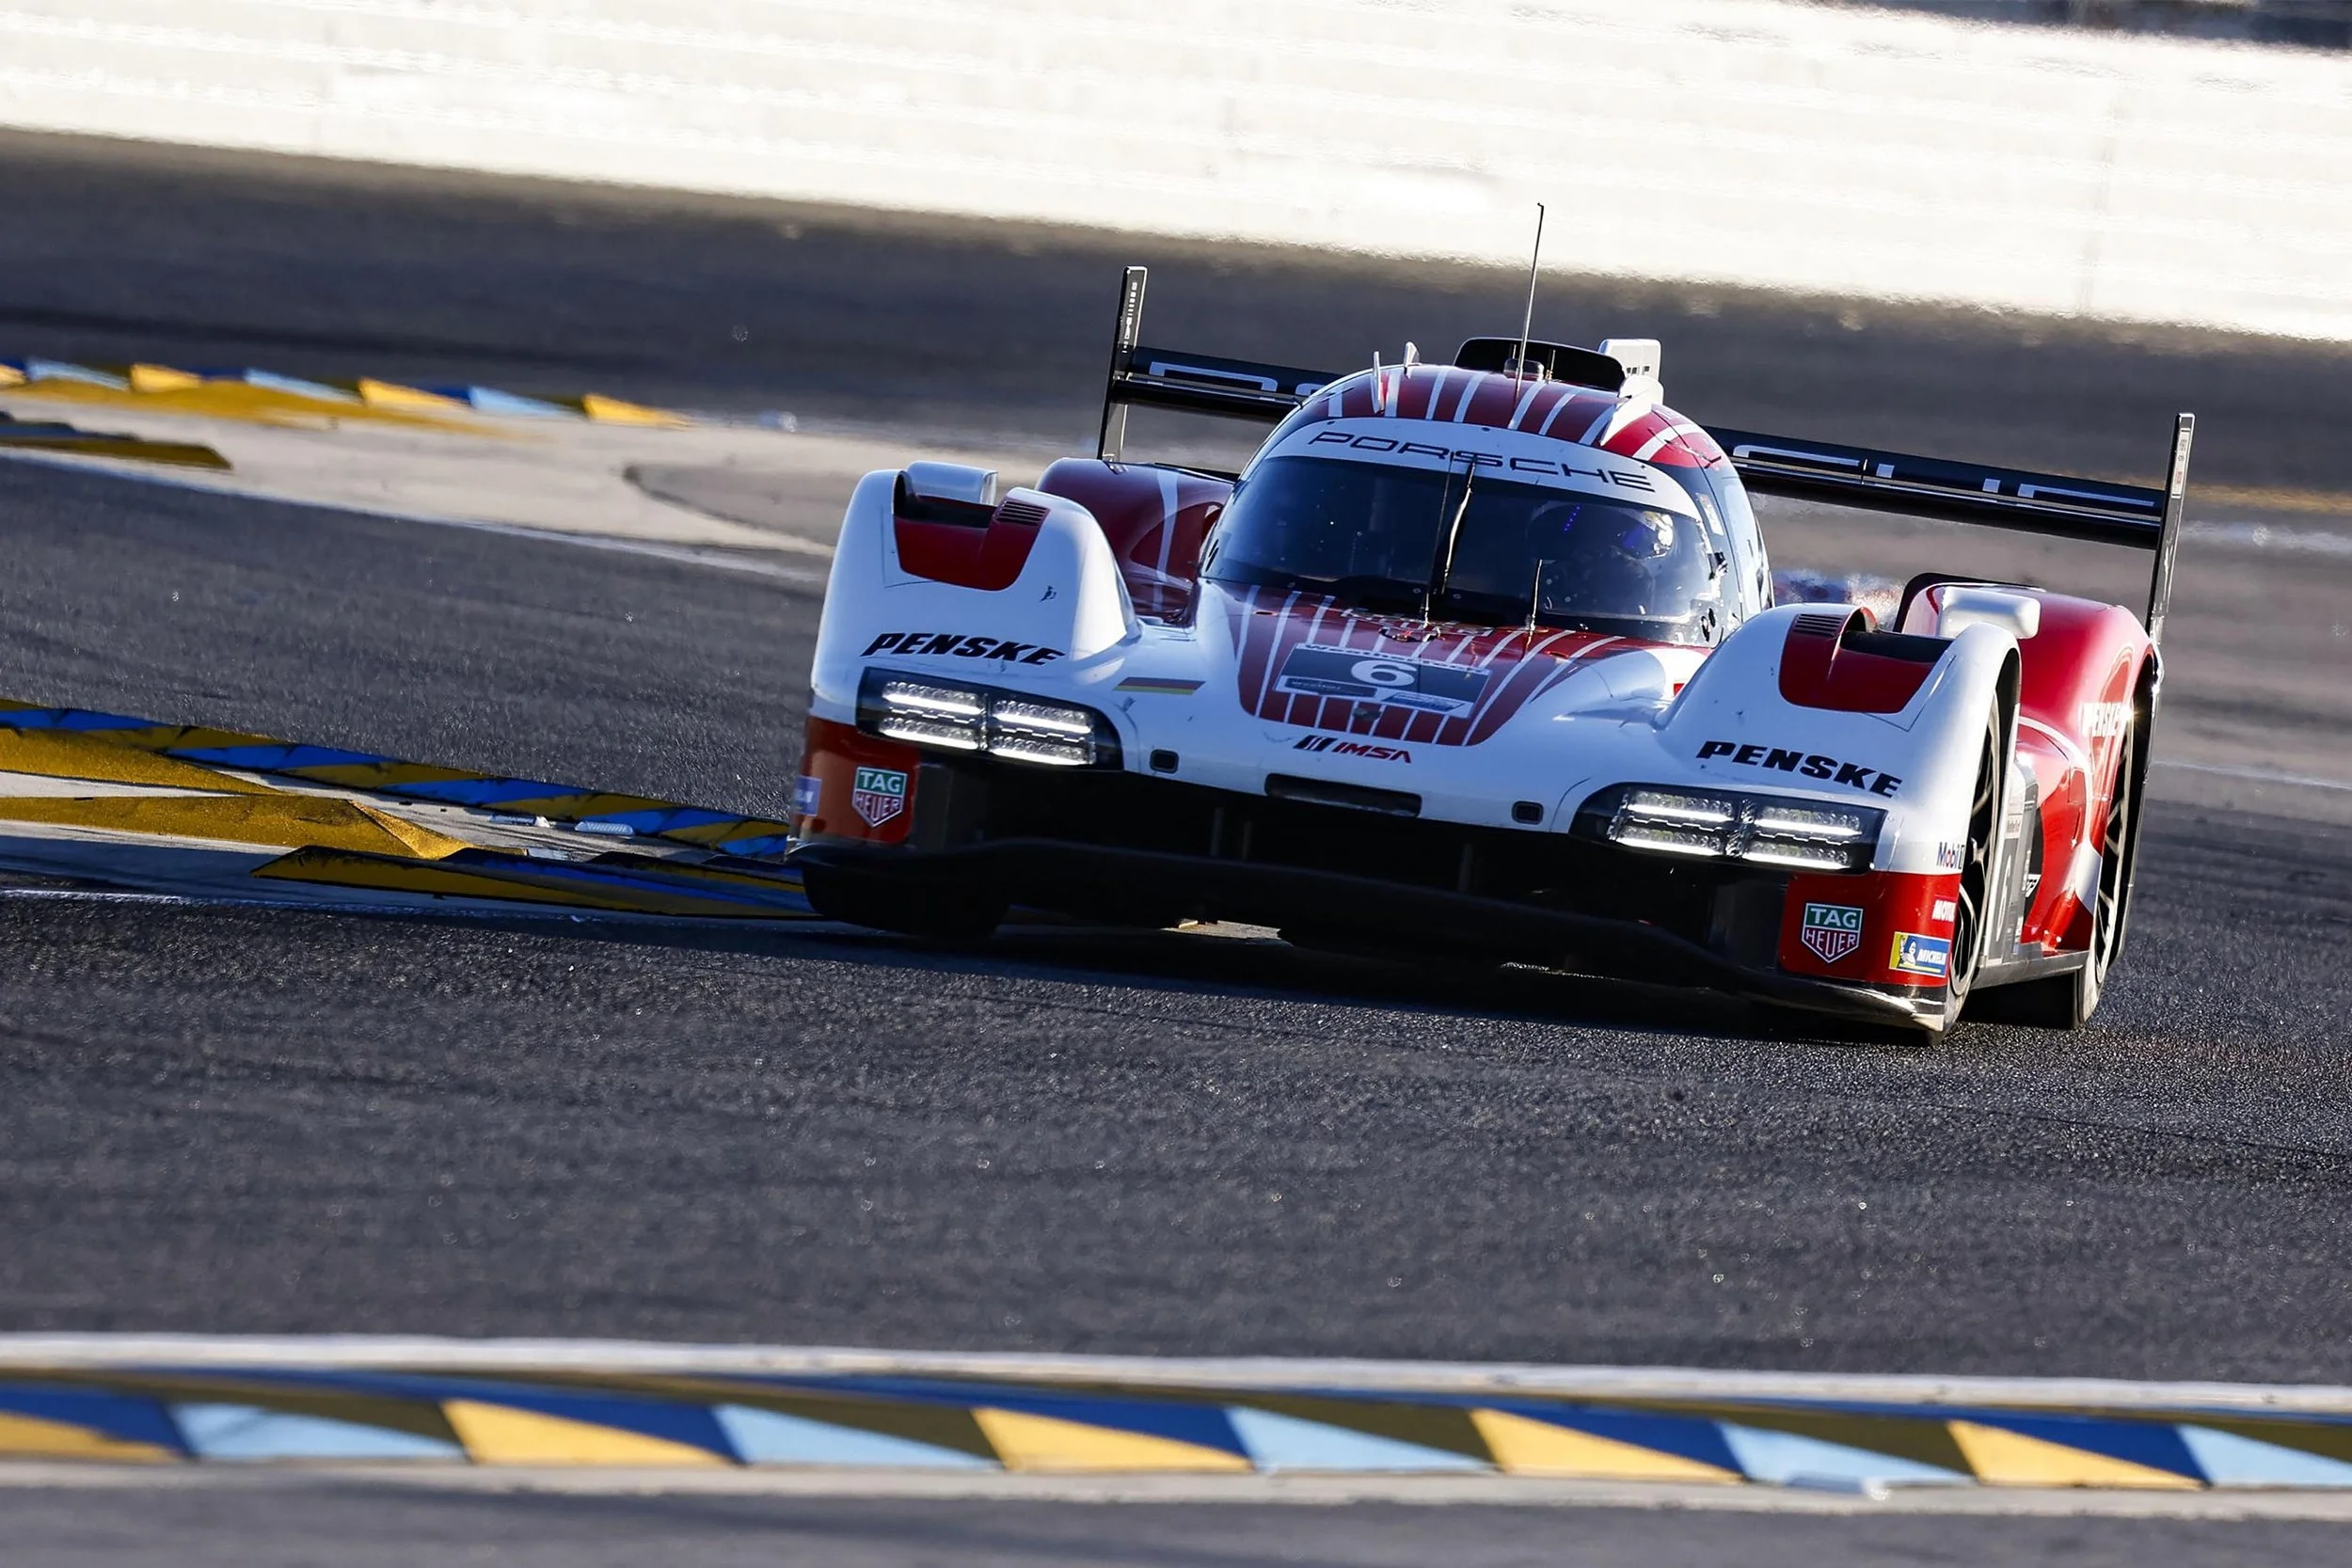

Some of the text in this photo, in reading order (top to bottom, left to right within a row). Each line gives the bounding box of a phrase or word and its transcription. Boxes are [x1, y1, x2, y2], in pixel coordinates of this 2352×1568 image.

[1309, 431, 1656, 492] PORSCHE
[860, 632, 1066, 666] PENSKE
[1350, 659, 1419, 687] 6
[1332, 741, 1412, 764] IMSA
[860, 771, 900, 793] TAG
[1695, 740, 1902, 799] PENSKE
[855, 793, 898, 821] HEUER
[1810, 908, 1857, 928] TAG
[1805, 929, 1856, 958] HEUER
